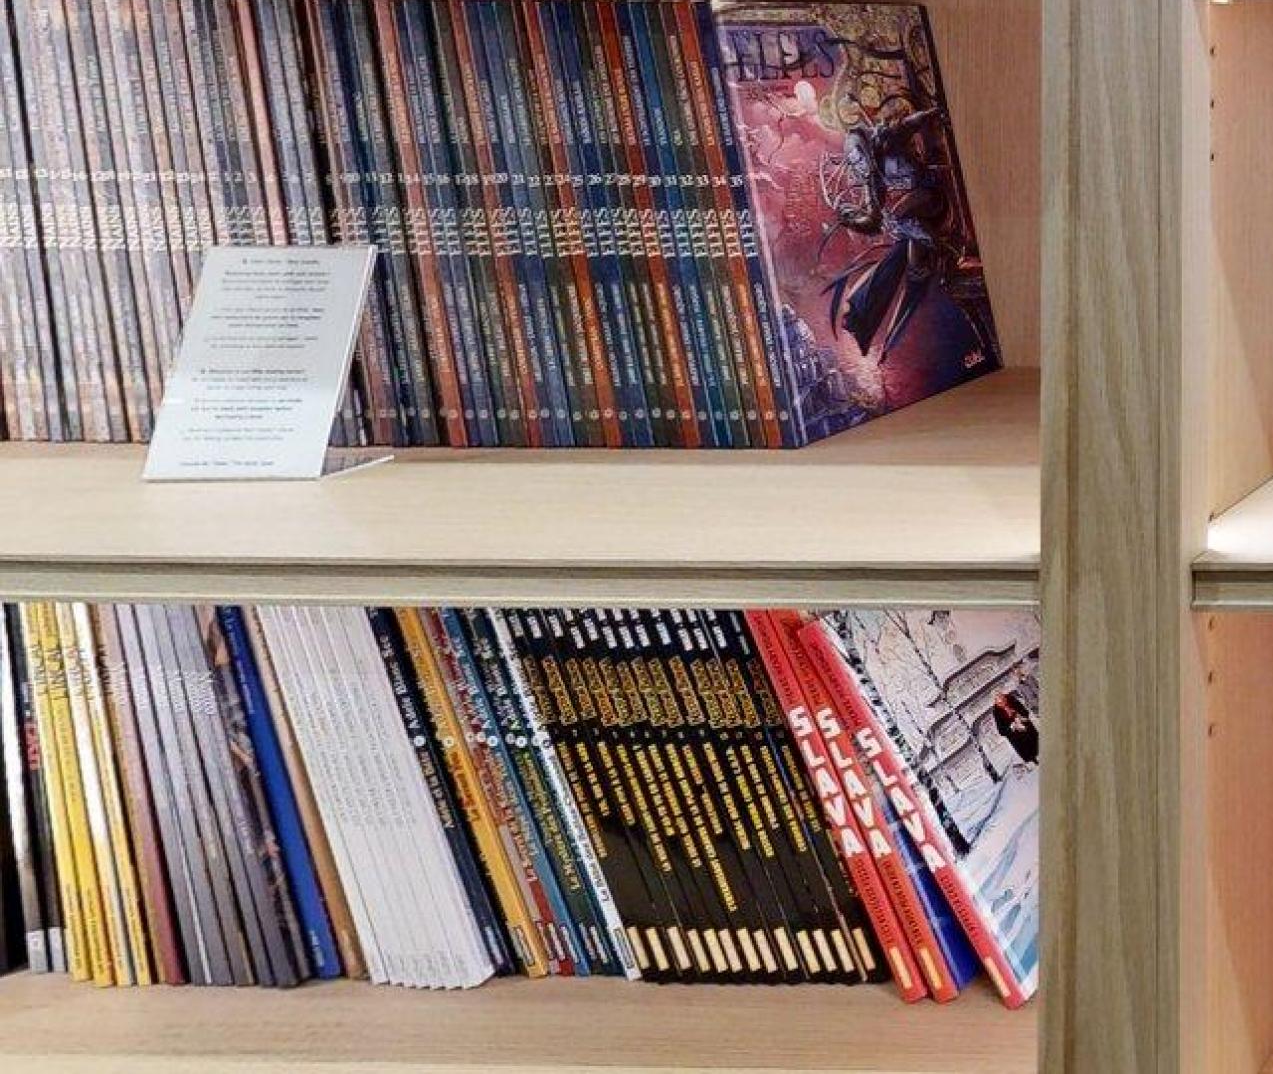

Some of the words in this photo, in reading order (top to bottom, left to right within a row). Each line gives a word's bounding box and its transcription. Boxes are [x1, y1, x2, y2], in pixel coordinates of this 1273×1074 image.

[789, 708, 864, 857] SLAVA
[817, 707, 890, 857] SLAVA
[855, 728, 947, 871] SLAVA
